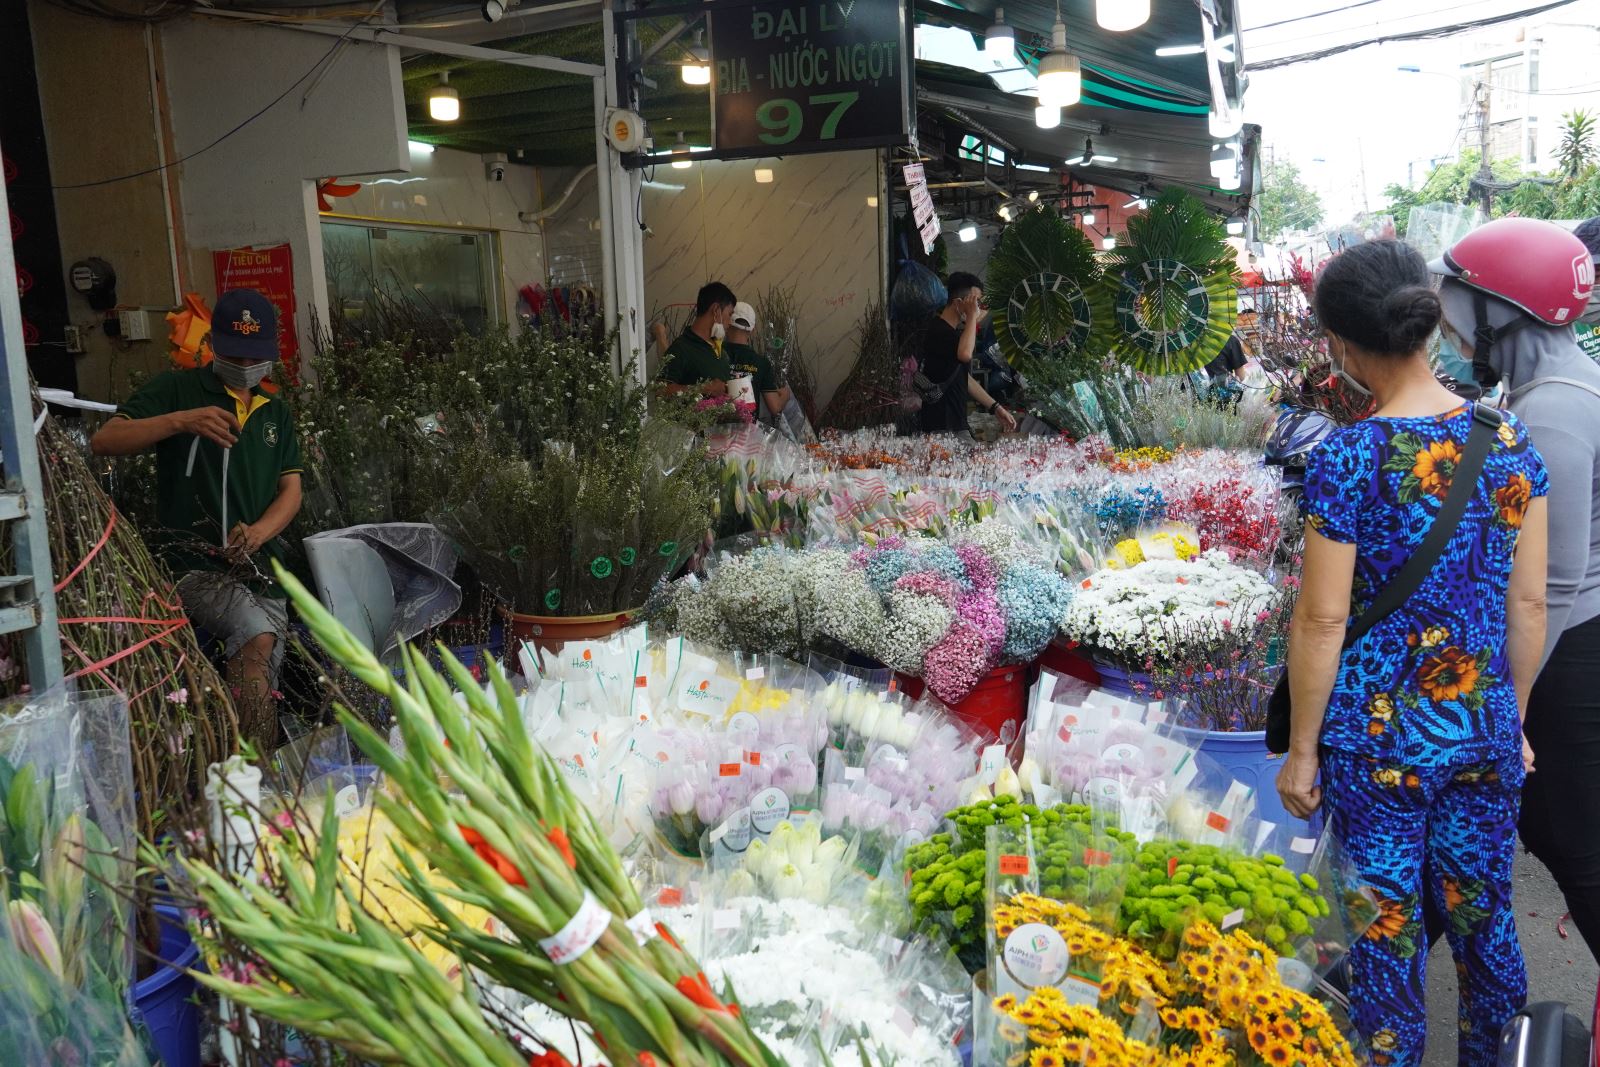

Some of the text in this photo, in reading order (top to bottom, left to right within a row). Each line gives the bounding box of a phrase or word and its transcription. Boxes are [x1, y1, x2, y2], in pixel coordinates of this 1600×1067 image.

[751, 6, 807, 42] ĐẠI
[717, 57, 750, 95] BIA
[769, 39, 828, 90] NƯỚC
[836, 41, 897, 87] NGỌT
[756, 91, 860, 145] 97
[232, 320, 262, 335] Tiger
[1008, 946, 1029, 957] AIPH
